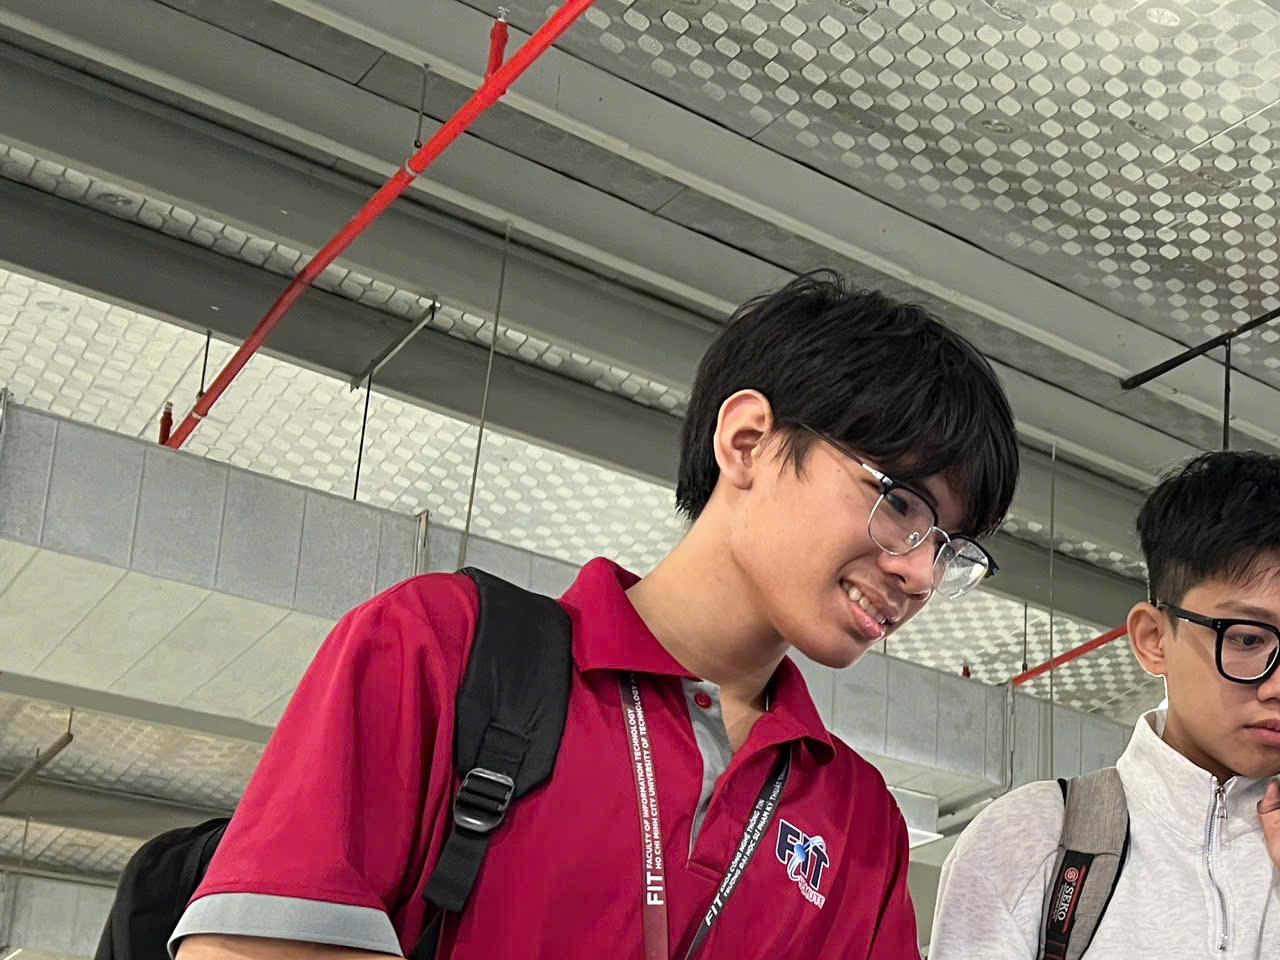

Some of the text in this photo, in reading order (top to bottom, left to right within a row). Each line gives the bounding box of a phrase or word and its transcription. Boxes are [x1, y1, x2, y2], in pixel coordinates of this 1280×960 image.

[632, 684, 647, 736] TECHNOLOGY
[641, 736, 650, 749] OF
[627, 708, 654, 869] FACULTY OF INFORMATION TECHNOLOGY
[643, 750, 655, 797] UNIVERSITY
[649, 797, 658, 816] CITY
[652, 818, 660, 839] MINH
[654, 841, 662, 855] CHI
[655, 856, 663, 869] HO
[646, 871, 664, 905] FIT
[1057, 885, 1074, 921] SEKO
[705, 893, 723, 927] FIT
